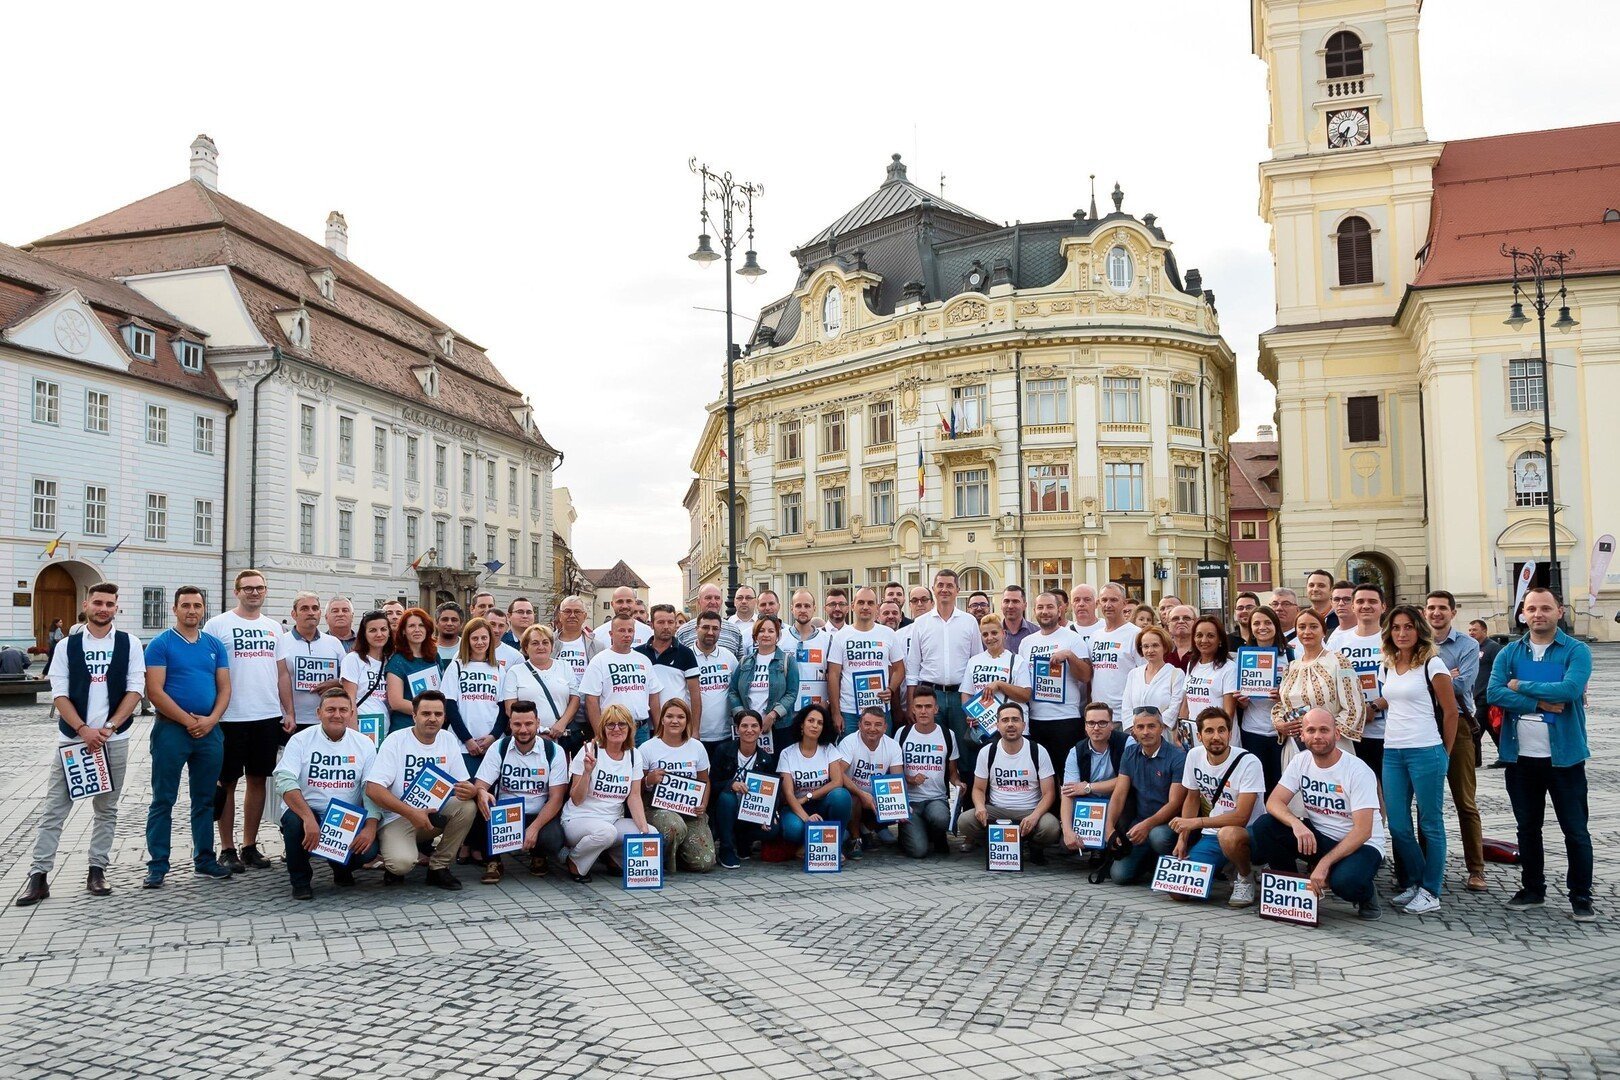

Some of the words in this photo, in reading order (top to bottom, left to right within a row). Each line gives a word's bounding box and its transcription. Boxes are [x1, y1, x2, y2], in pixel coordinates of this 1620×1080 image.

[233, 628, 262, 638] Dan
[234, 639, 275, 650] Barna
[846, 641, 871, 650] Dan
[1031, 644, 1049, 653] Dan
[1093, 641, 1110, 650] Dan
[85, 650, 106, 661] an
[557, 650, 574, 658] an
[847, 650, 883, 661] Barna
[1341, 647, 1371, 658] Dan
[297, 658, 323, 670] Dan
[608, 663, 635, 674] Dan
[701, 664, 717, 674] an
[973, 665, 998, 673] Dan
[297, 670, 334, 681] Barna
[460, 671, 486, 681] Dan
[1242, 669, 1262, 678] Dan
[611, 674, 646, 685] Barna
[701, 674, 728, 685] arna
[1037, 677, 1054, 685] Dan
[1241, 678, 1271, 687] Barna
[460, 682, 497, 695] Barna
[1036, 685, 1061, 694] Barna
[979, 709, 994, 722] Dan
[905, 742, 931, 752] Dan
[310, 752, 341, 765] Dan
[905, 753, 942, 764] Barna
[80, 747, 100, 794] Barna
[502, 764, 530, 777] Dan
[658, 761, 682, 771] Dan
[857, 760, 875, 771] Dan
[308, 766, 356, 780] Barna
[597, 770, 619, 782] Dan
[795, 771, 818, 780] Dan
[995, 768, 1017, 777] Dan
[1194, 768, 1218, 786] Dan
[68, 764, 85, 798] Dan
[502, 777, 544, 790] Barna
[660, 775, 688, 791] Dan
[996, 778, 1029, 786] Barna
[1301, 775, 1328, 793] Dan
[594, 781, 628, 794] Barna
[411, 786, 431, 803] Dan
[656, 786, 698, 806] Barna
[744, 793, 763, 803] Dan
[1302, 790, 1346, 810] Barna
[742, 801, 770, 813] Barna
[1074, 819, 1093, 828] Dan
[321, 824, 343, 839] Dan
[492, 826, 513, 835] Dan
[1074, 827, 1101, 837] Barna
[492, 832, 521, 844] Barna
[990, 844, 1009, 852] Dan
[809, 853, 837, 861] Barna
[990, 852, 1018, 860] Barna
[628, 859, 649, 867] Dan
[1159, 858, 1192, 873] Dan
[628, 868, 658, 877] Barna
[1156, 870, 1204, 888] Barna
[1264, 874, 1298, 892] Dan
[1263, 890, 1313, 909] Barna
